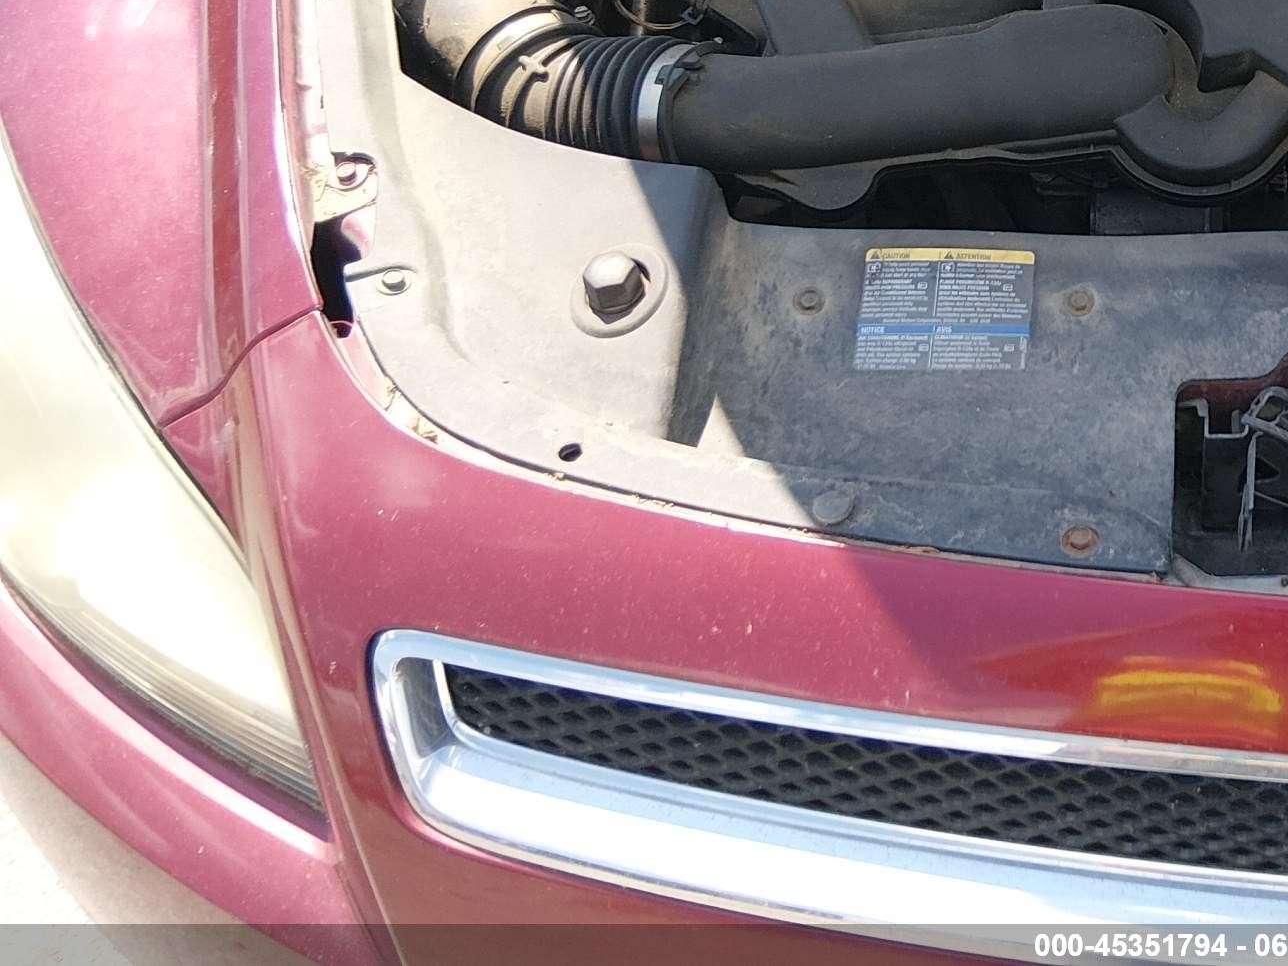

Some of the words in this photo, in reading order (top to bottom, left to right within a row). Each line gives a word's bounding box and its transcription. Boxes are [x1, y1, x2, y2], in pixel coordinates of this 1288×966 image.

[882, 251, 911, 259] CAUTION
[956, 252, 992, 261] ATTENTION
[860, 326, 885, 334] NOTICE
[936, 325, 953, 333] AVIS
